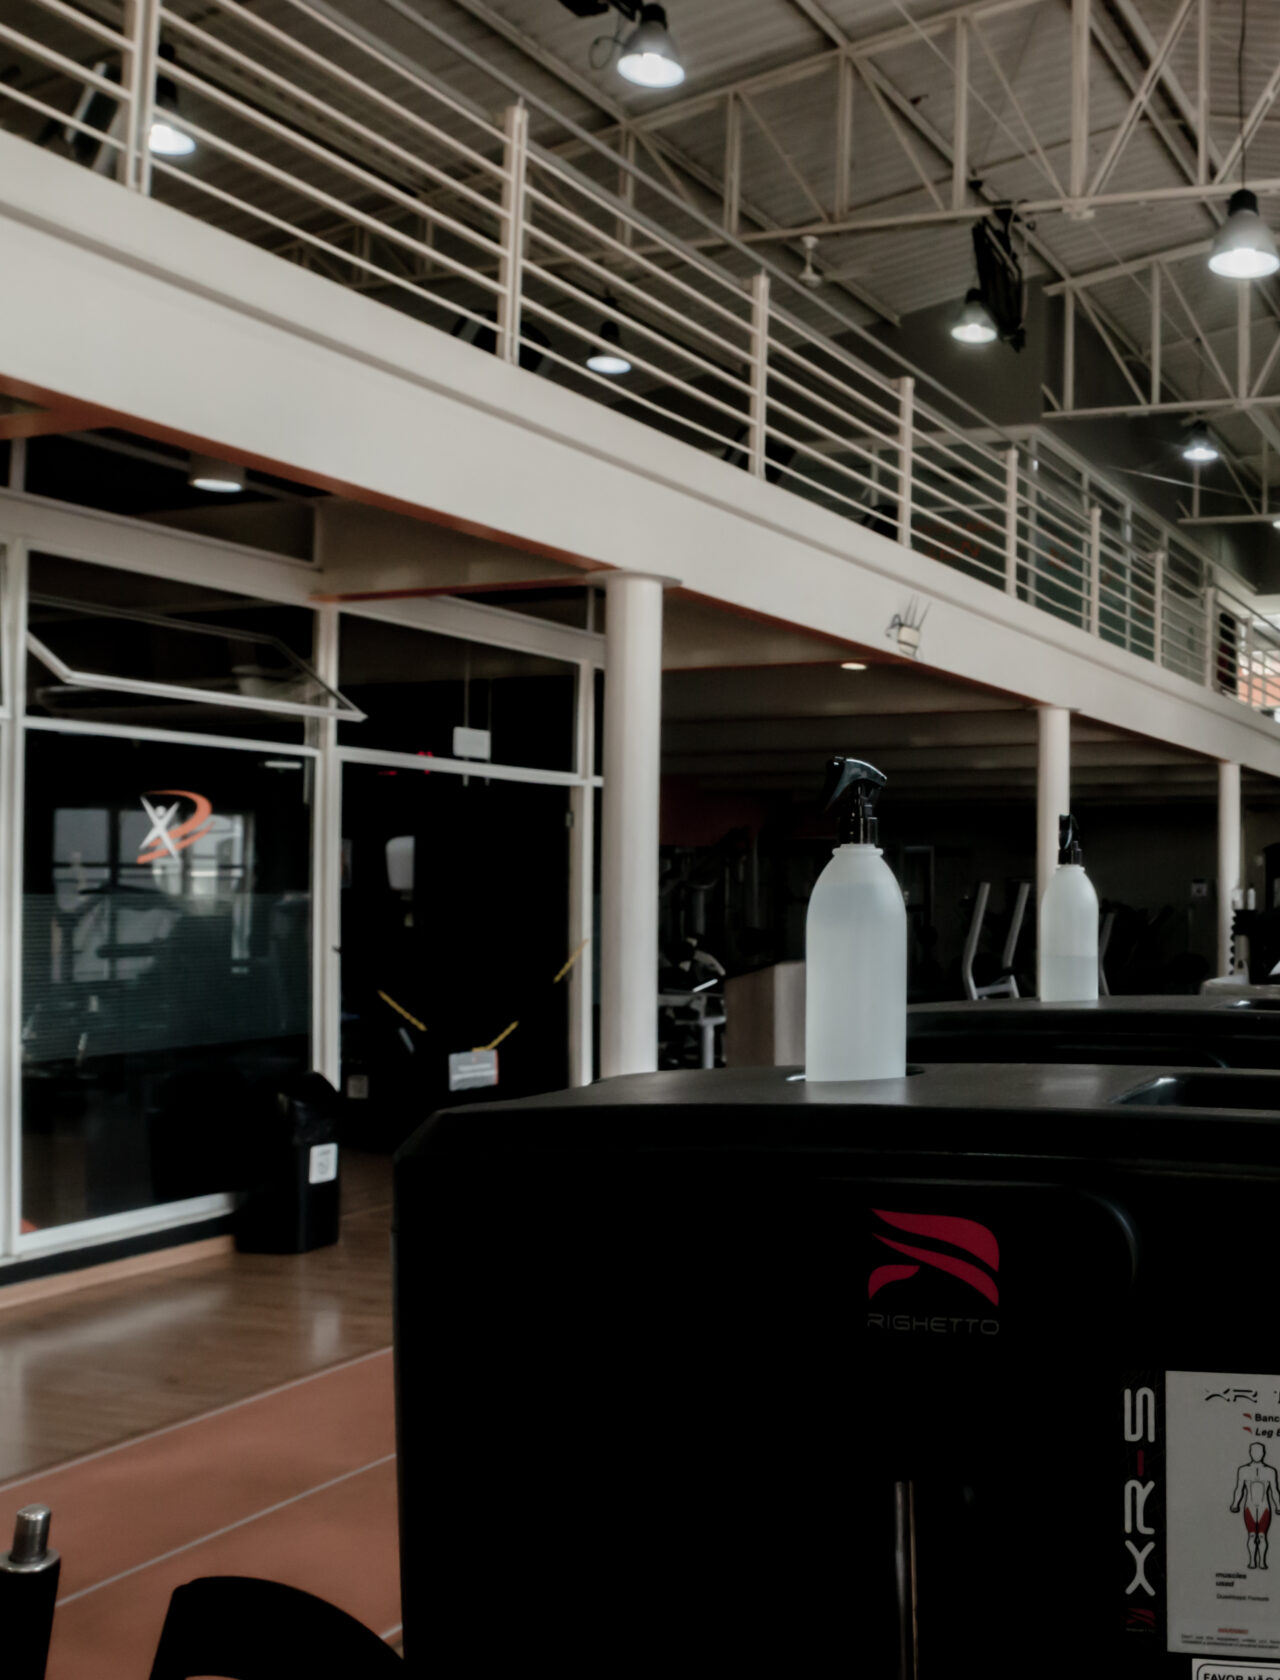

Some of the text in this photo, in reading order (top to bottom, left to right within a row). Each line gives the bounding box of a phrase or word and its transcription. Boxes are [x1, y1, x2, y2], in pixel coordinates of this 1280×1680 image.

[867, 1313, 1000, 1335] RIGHETTO
[1204, 1388, 1258, 1403] XR
[1255, 1427, 1274, 1439] Leg
[1123, 1386, 1156, 1597] XR-S
